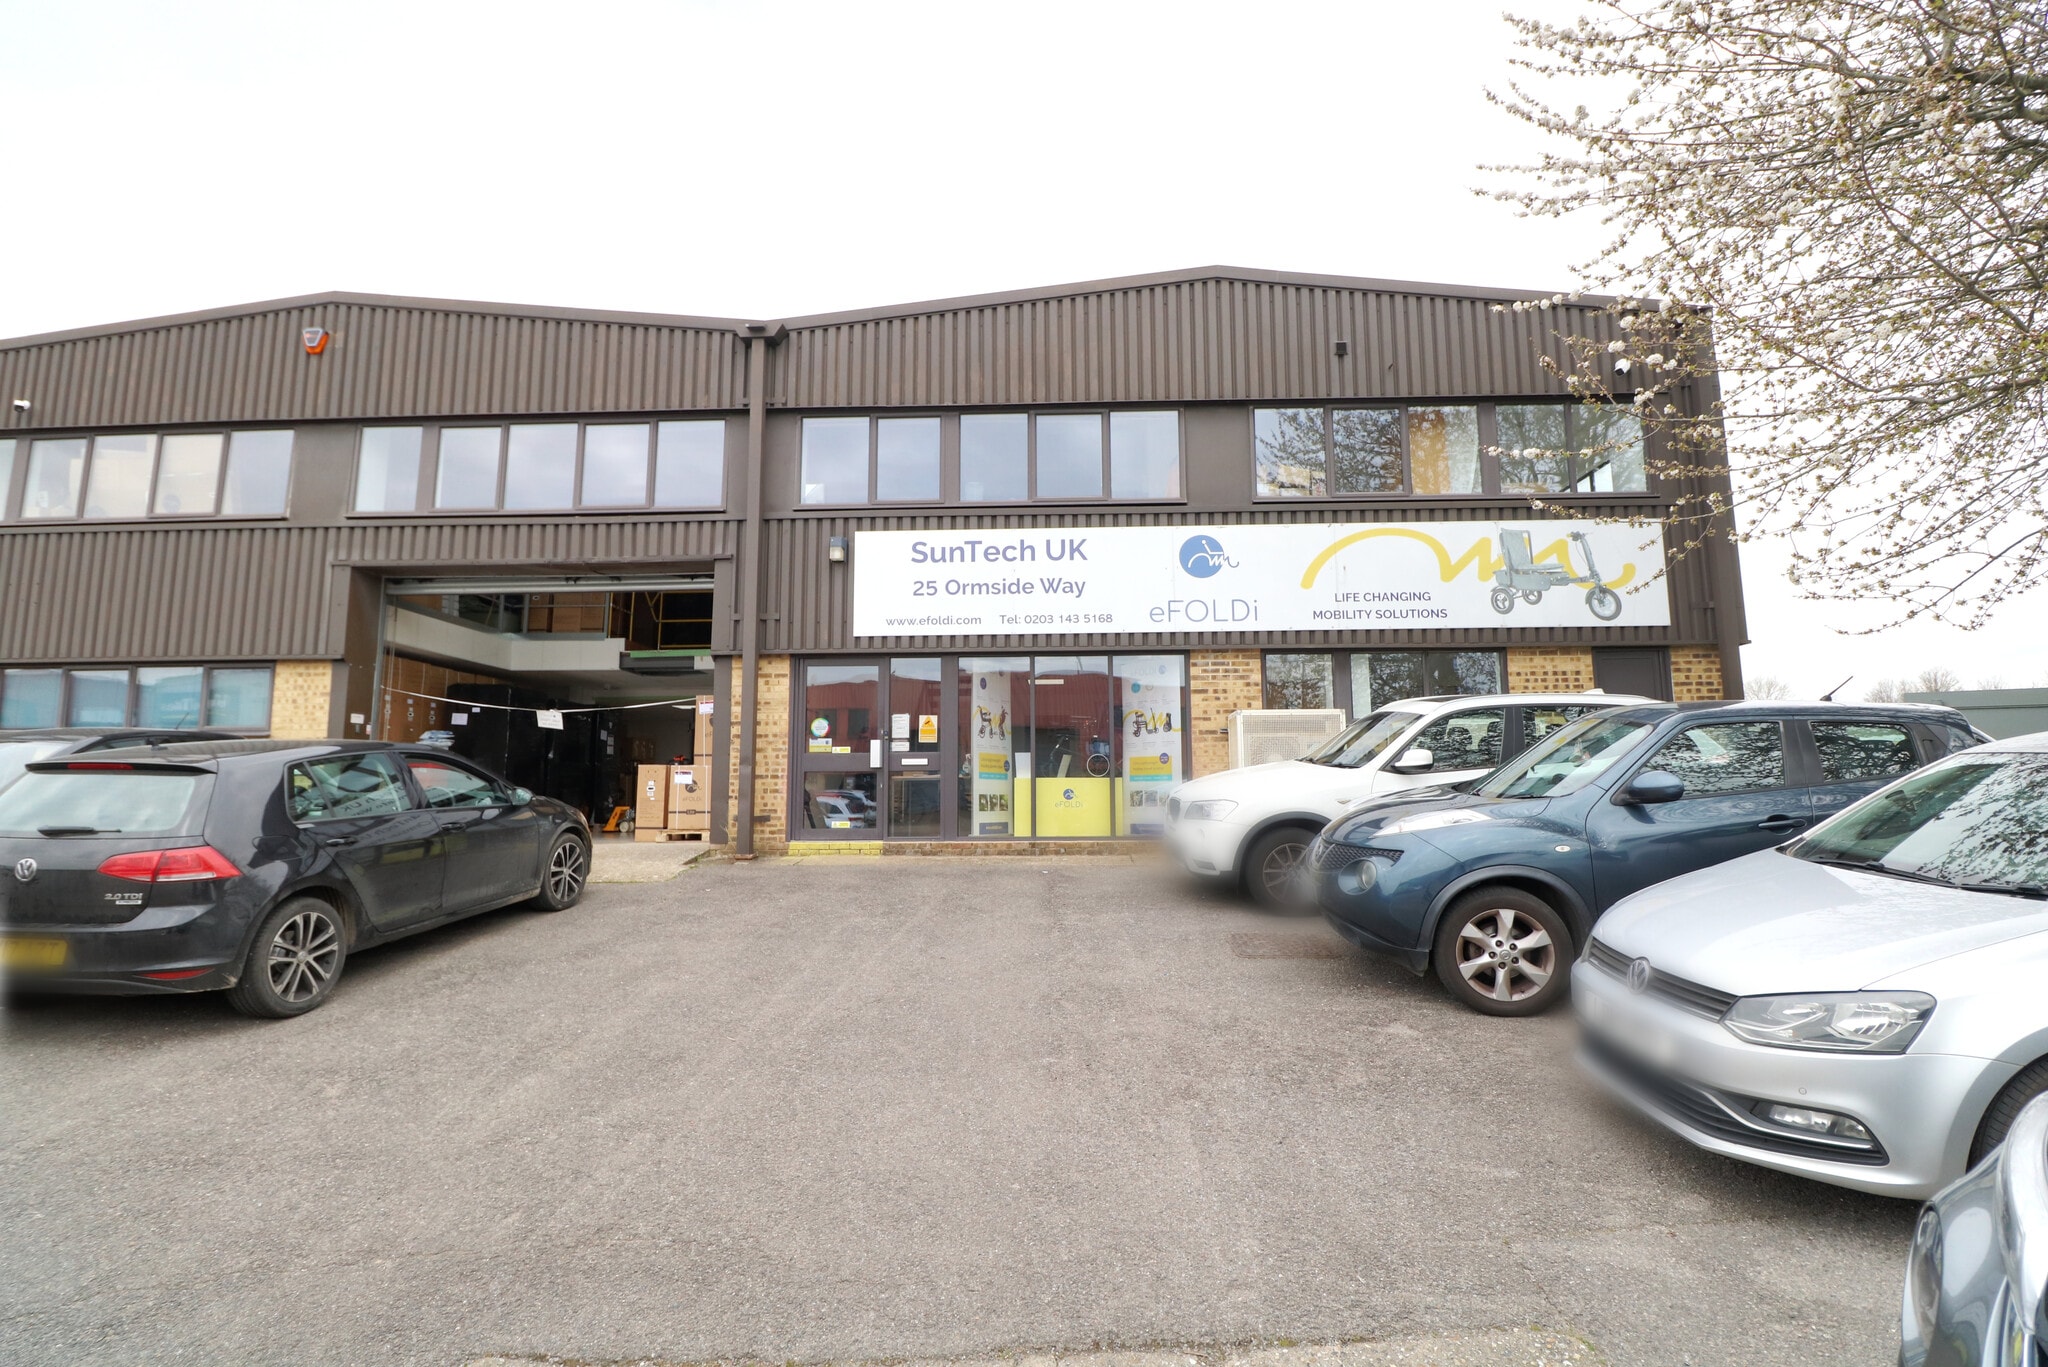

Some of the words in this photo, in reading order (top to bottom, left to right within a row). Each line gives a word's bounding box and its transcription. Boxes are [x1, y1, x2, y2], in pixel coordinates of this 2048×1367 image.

[911, 539, 1036, 563] SunTech
[1045, 539, 1088, 562] UK
[912, 580, 938, 597] 25
[944, 578, 1035, 596] Ormside
[1039, 577, 1086, 599] Way
[1334, 592, 1361, 603] LIFE
[1363, 591, 1432, 603] CHANGING
[1149, 598, 1258, 623] eFOLDi
[1312, 609, 1372, 621] MOBILITY
[1375, 608, 1448, 620] SOLUTIONS
[885, 615, 982, 626] www.efoldi.com
[999, 614, 1021, 625] Tel:
[1024, 614, 1054, 625] 0203
[1059, 614, 1080, 625] 143
[1083, 613, 1113, 624] 5168
